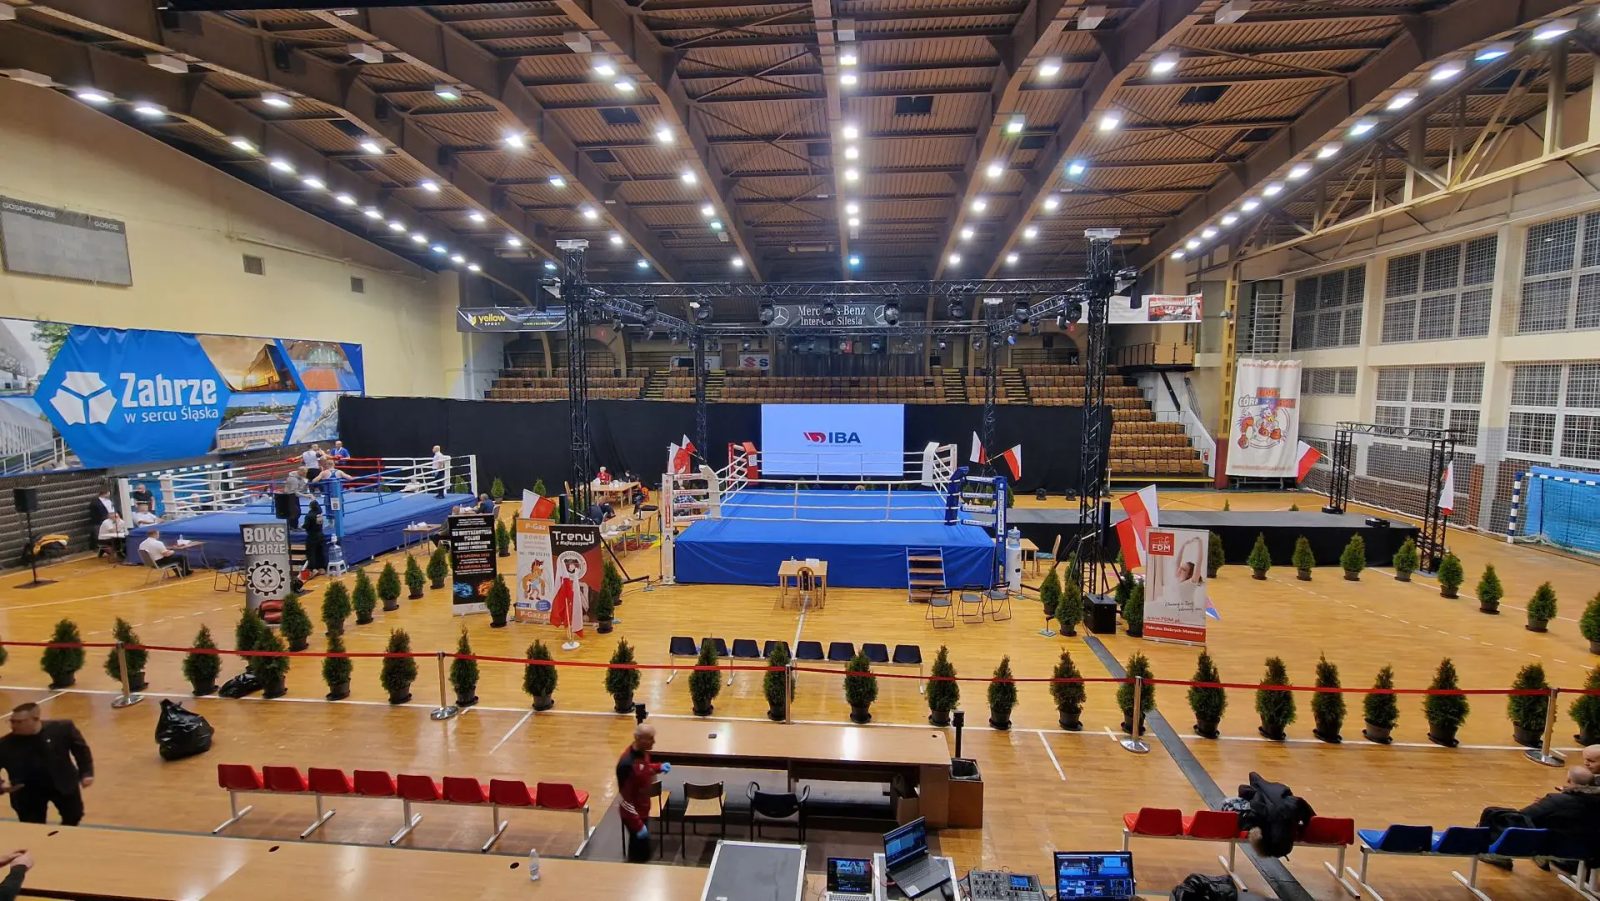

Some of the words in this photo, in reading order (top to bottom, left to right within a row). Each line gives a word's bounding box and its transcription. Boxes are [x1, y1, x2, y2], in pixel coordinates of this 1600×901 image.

[2, 202, 56, 218] GOSPODARZE
[799, 305, 866, 316] Mercs-Benz
[478, 313, 506, 324] yellow
[800, 316, 835, 326] Inter-Car
[836, 316, 863, 326] Silesia
[119, 372, 217, 408] Zabrze
[124, 412, 136, 423] w
[141, 410, 177, 423] sercu
[180, 405, 219, 422] Śląska
[828, 431, 861, 444] IBA
[242, 527, 286, 543] BOKS
[552, 530, 595, 544] Trenuj
[244, 543, 287, 555] ZABRZE
[1152, 543, 1171, 552] FDM
